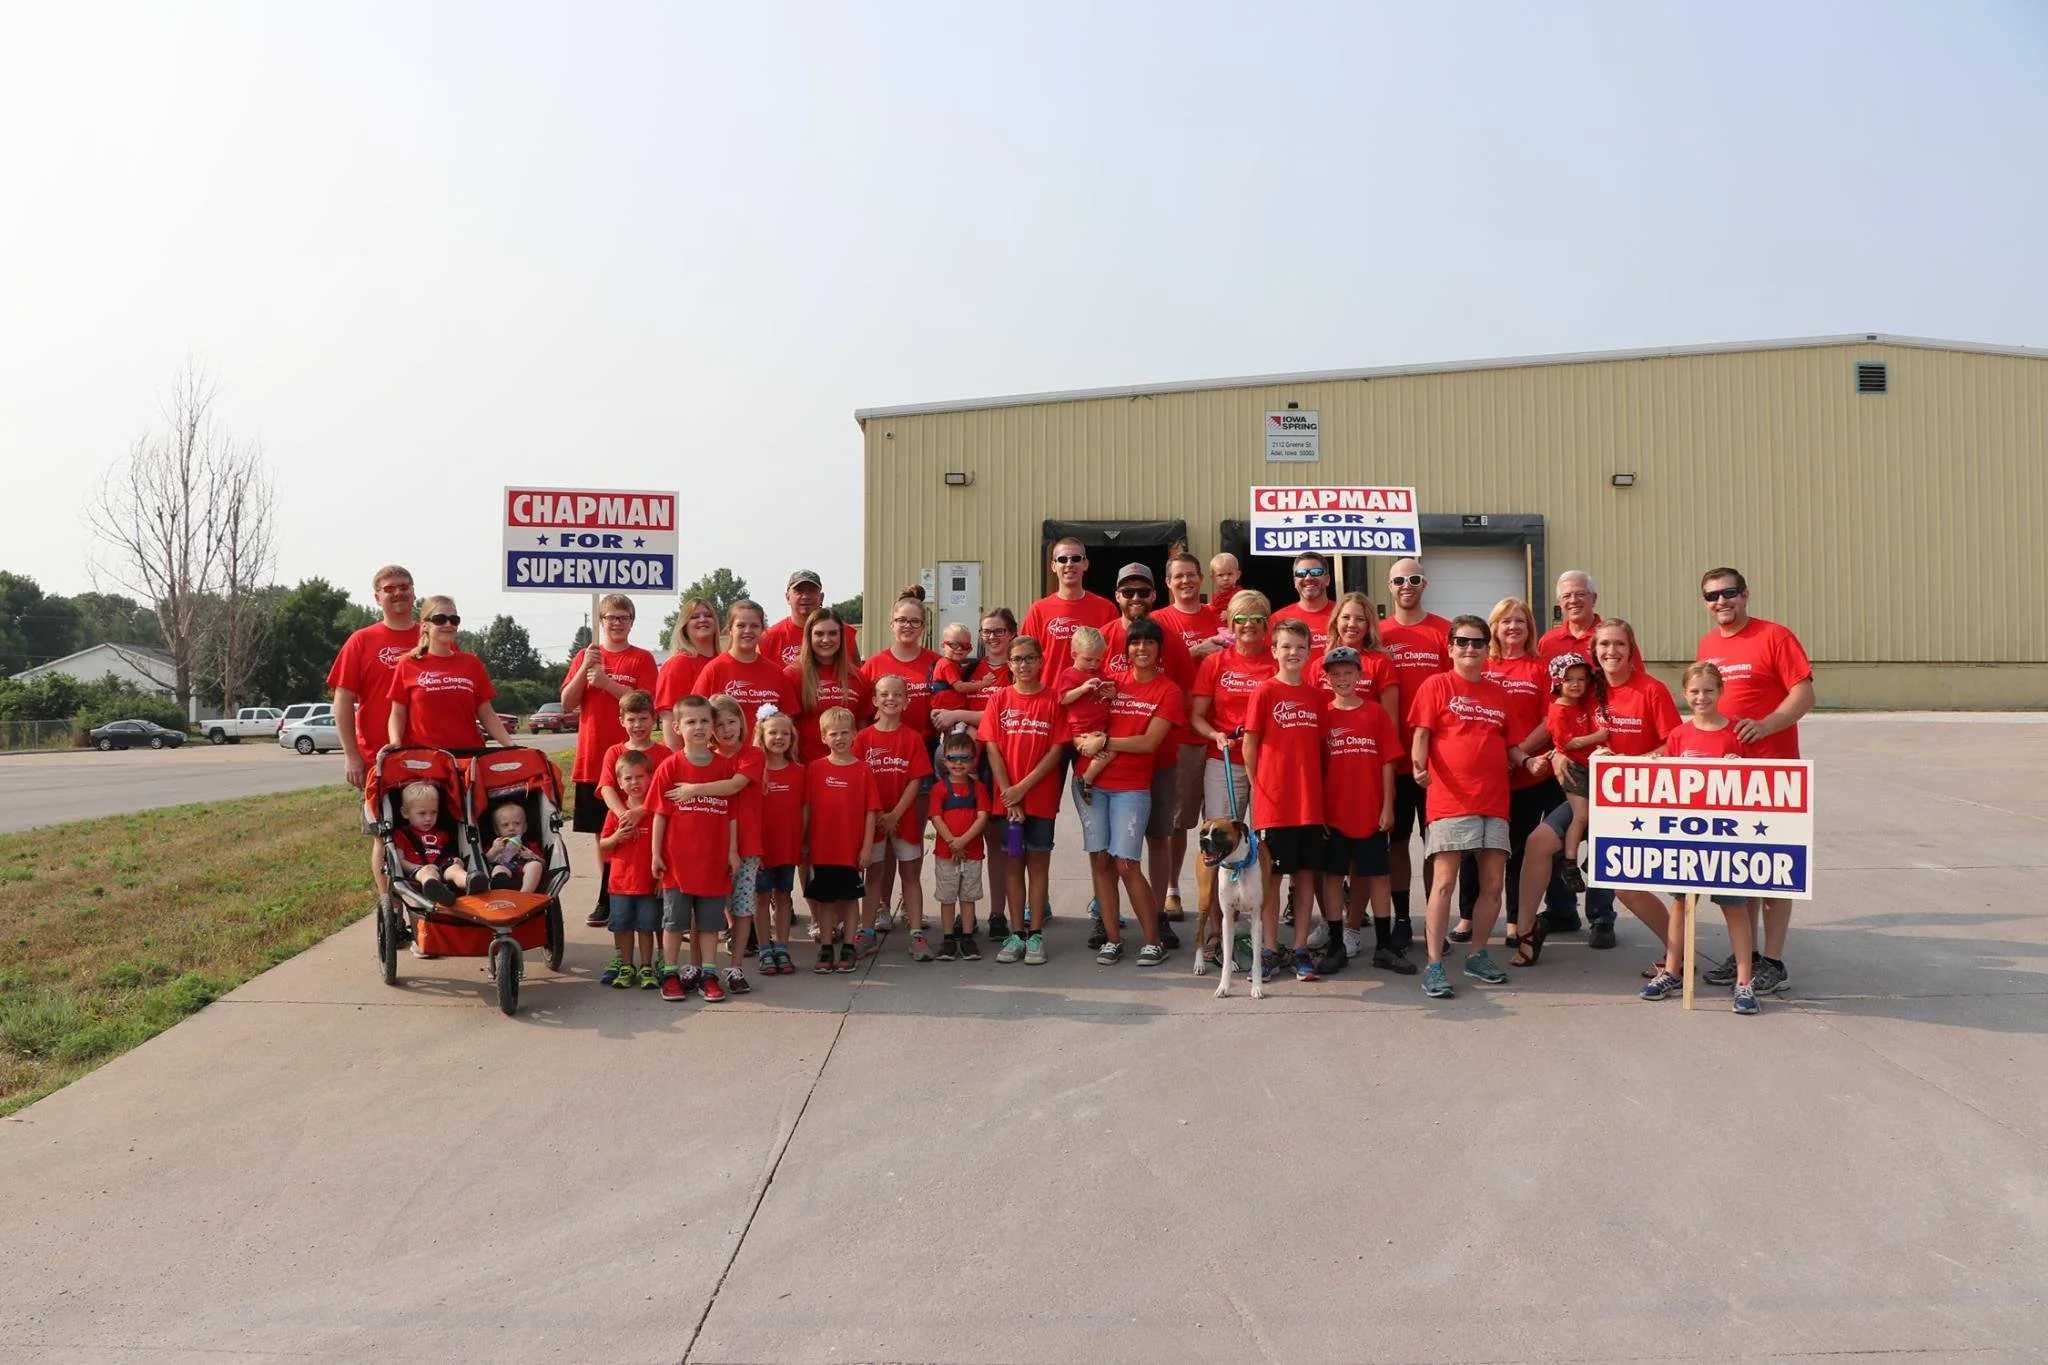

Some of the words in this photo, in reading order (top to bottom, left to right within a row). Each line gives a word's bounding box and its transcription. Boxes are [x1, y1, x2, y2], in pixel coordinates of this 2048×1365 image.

[513, 494, 670, 527] CHAPMAN
[1259, 490, 1408, 511] CHAPMAN
[1305, 514, 1364, 524] FOR
[560, 533, 623, 549] FOR
[1264, 530, 1406, 550] SUPERVISOR
[516, 557, 664, 586] SUPERVISOR
[1403, 651, 1439, 660] Chapman
[1281, 711, 1297, 721] Kim
[1458, 704, 1474, 713] Kim
[1601, 767, 1801, 807] CHAPMAN
[1659, 816, 1739, 836] FOR
[1606, 845, 1794, 886] SUPERVISOR
